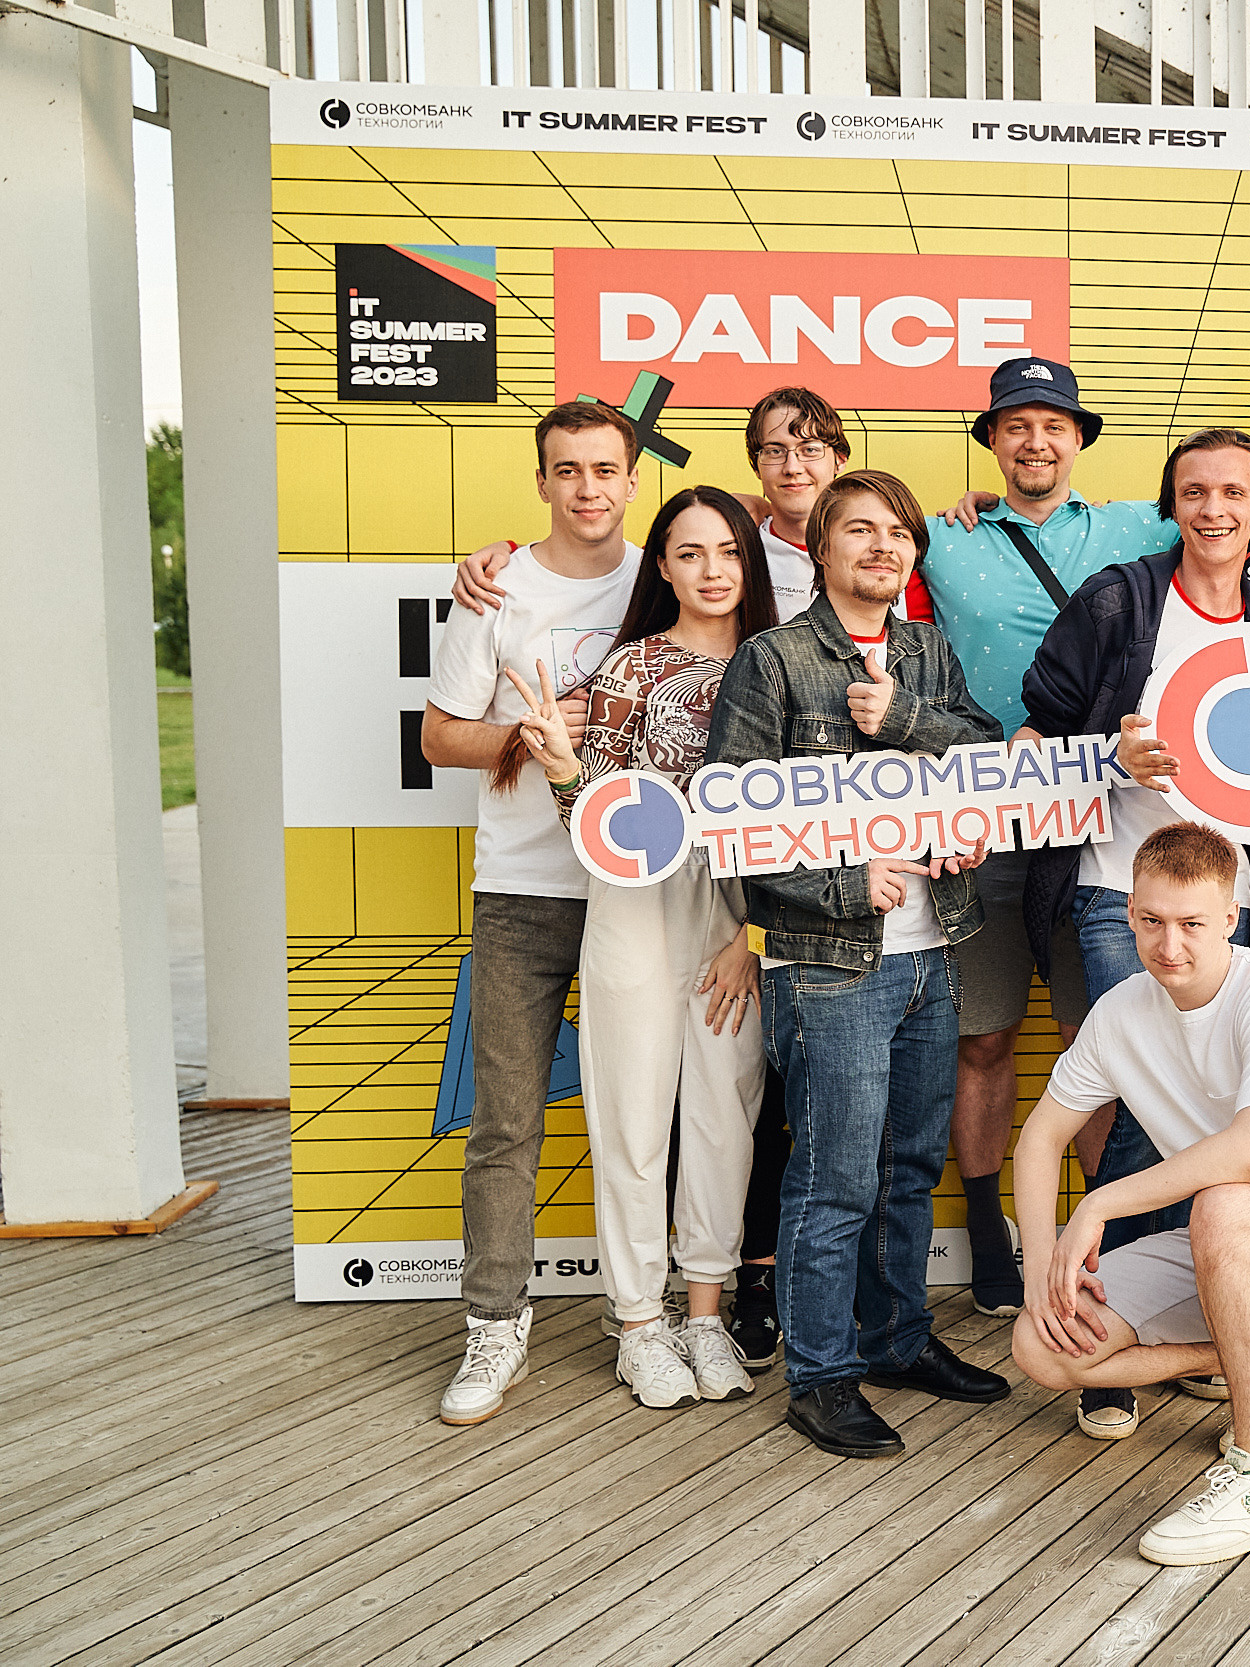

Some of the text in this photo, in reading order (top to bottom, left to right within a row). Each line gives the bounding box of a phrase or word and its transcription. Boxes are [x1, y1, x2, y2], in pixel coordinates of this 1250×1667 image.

[356, 102, 472, 118] СОВКОМБАНК
[356, 117, 443, 129] ТЕХНОЛОГИИ
[502, 110, 768, 134] IT SUMMER FEST
[831, 115, 943, 129] СОВКОМБАНК
[832, 129, 915, 141] ТЕХНОЛОГИИ
[972, 122, 1227, 148] IT SUMMER FEST
[350, 320, 487, 342] SUMMER
[599, 291, 1033, 368] DANCE
[350, 343, 433, 364] FEST
[350, 365, 439, 387] 2023
[698, 740, 1132, 814] СОВКОМБАНК
[700, 796, 1106, 870] ТЕХНОЛОГИИ
